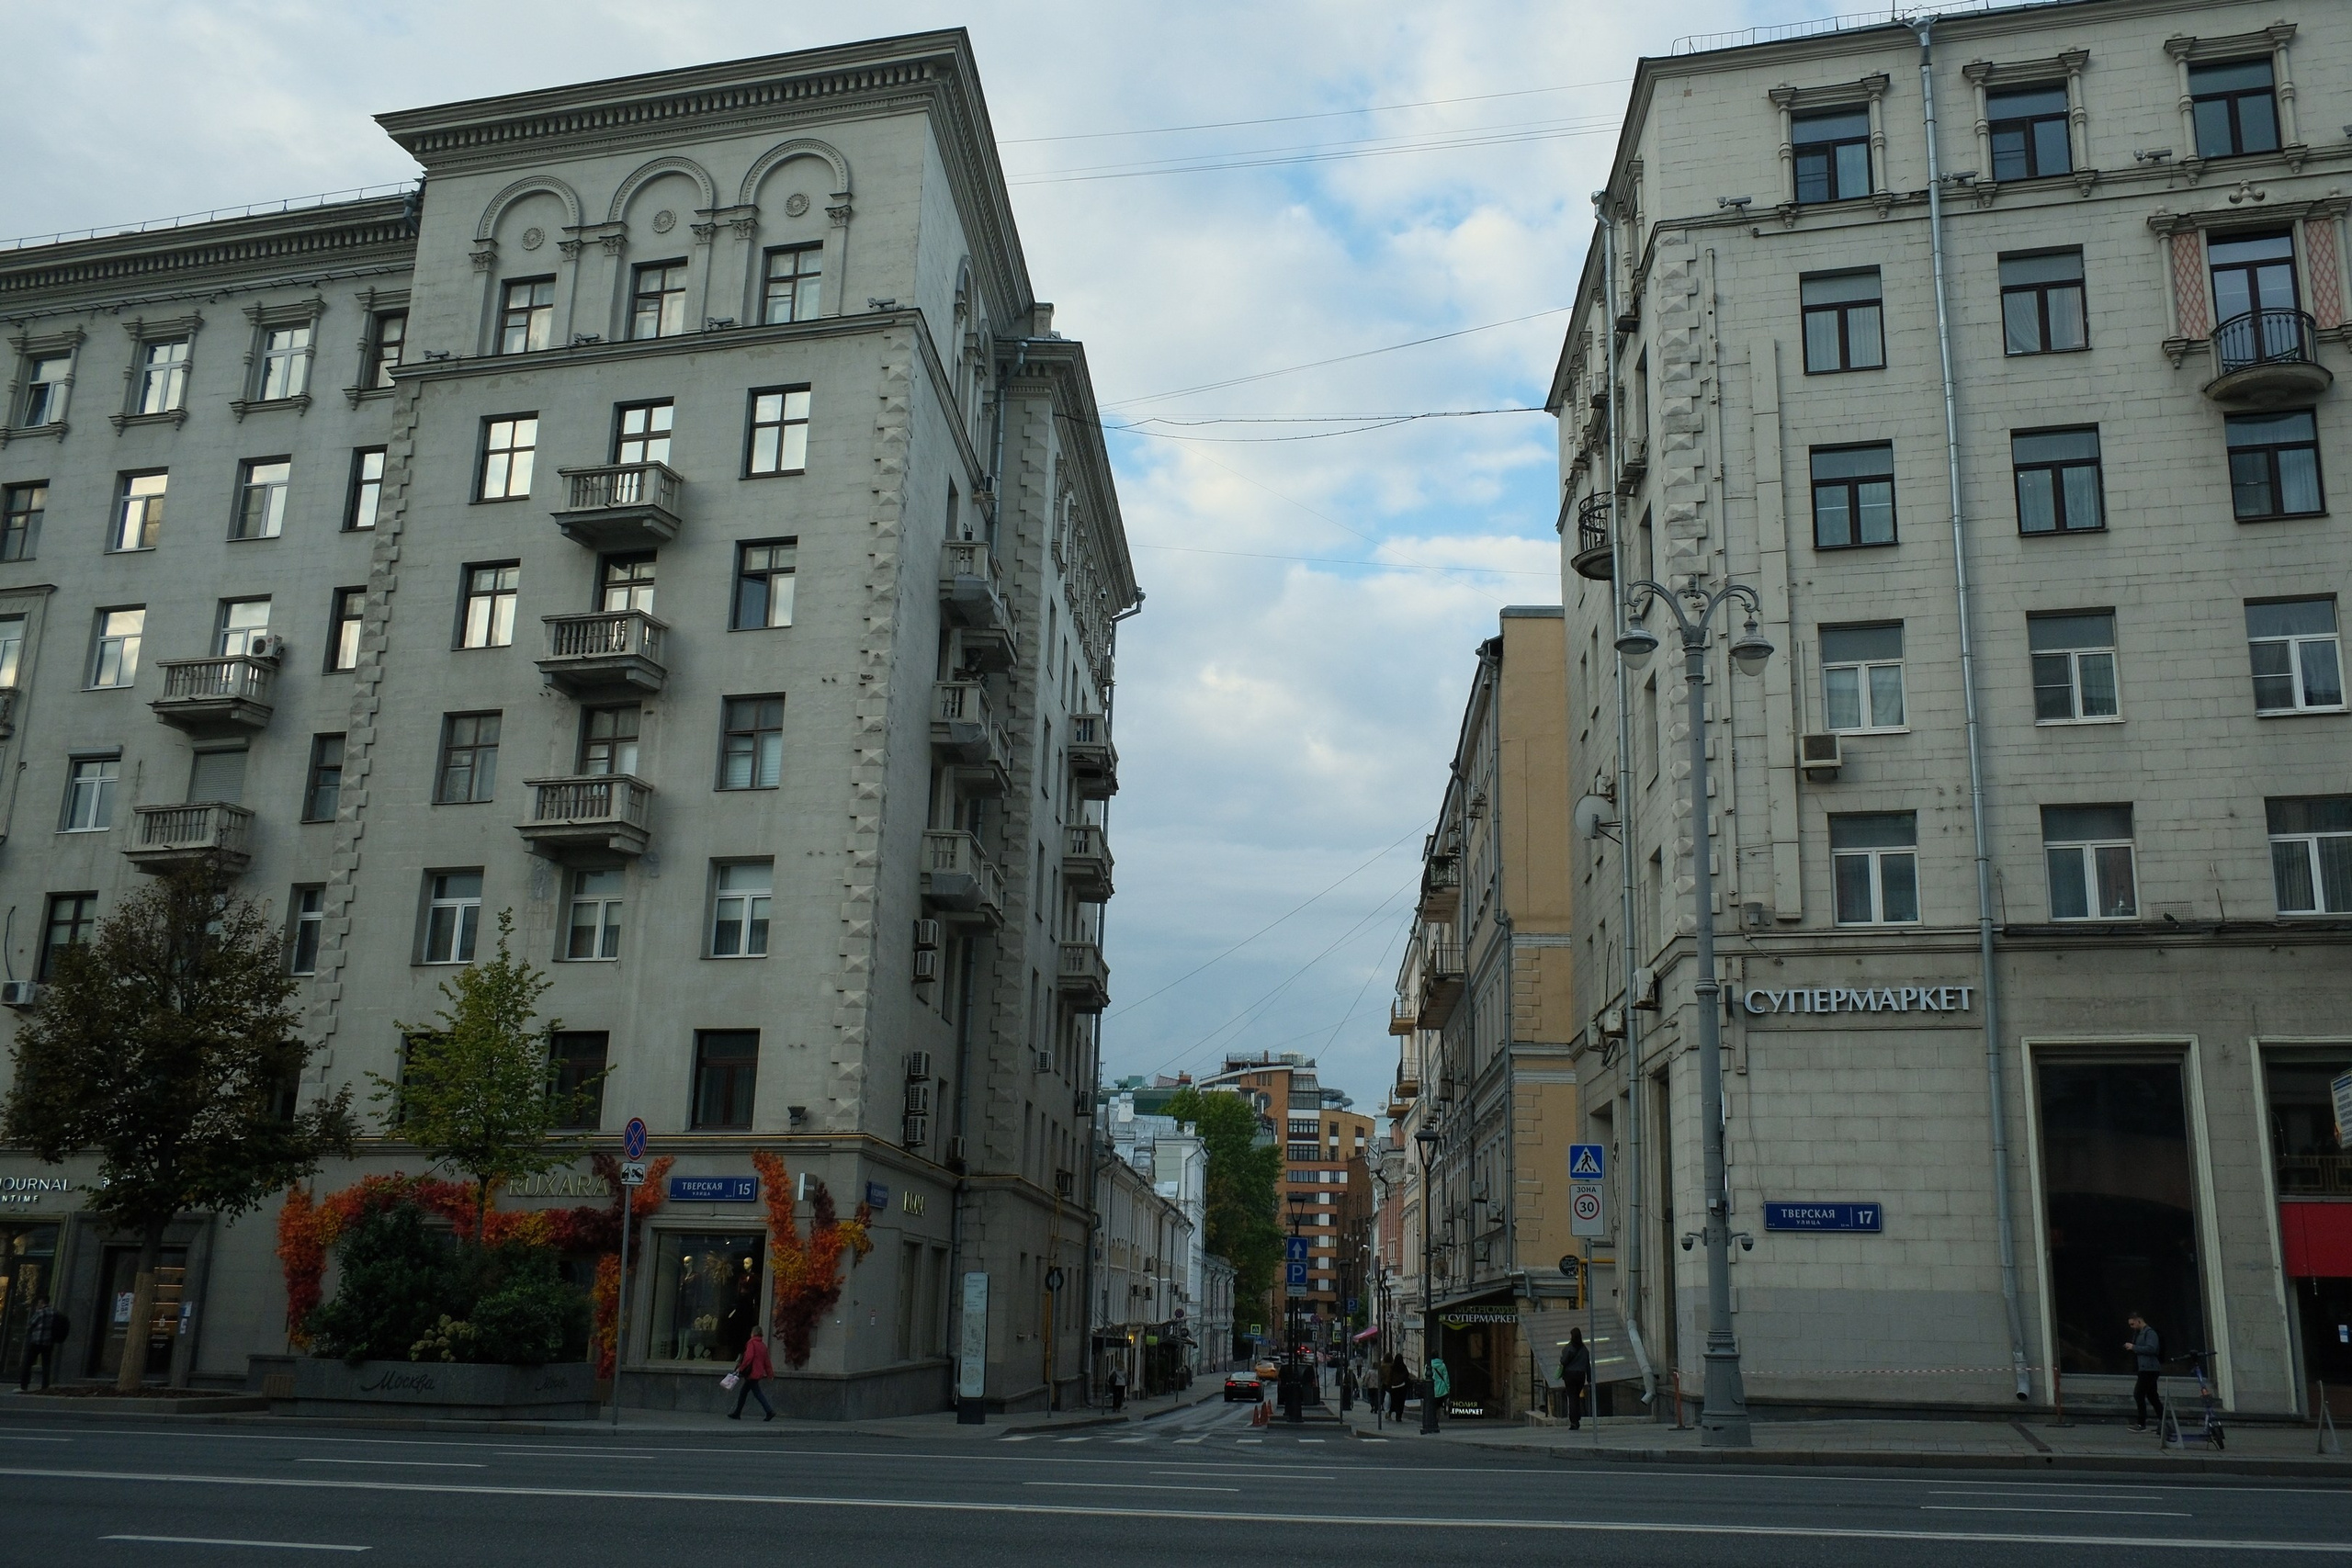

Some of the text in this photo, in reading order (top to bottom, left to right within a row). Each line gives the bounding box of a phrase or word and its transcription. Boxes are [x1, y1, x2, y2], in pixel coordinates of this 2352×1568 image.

[1744, 987, 1973, 1014] СУПЕРМАРКЕТ
[508, 1174, 608, 1196] RUXARA
[682, 1181, 751, 1196] ТВЕРСКАЯ 15
[1579, 1201, 1594, 1213] 30
[1781, 1209, 1873, 1224] ТВЕРСКАЯ 17
[1292, 1265, 1304, 1281] P
[1448, 1314, 1518, 1323] СУПЕРМАРКЕТ
[360, 1371, 435, 1393] Москва
